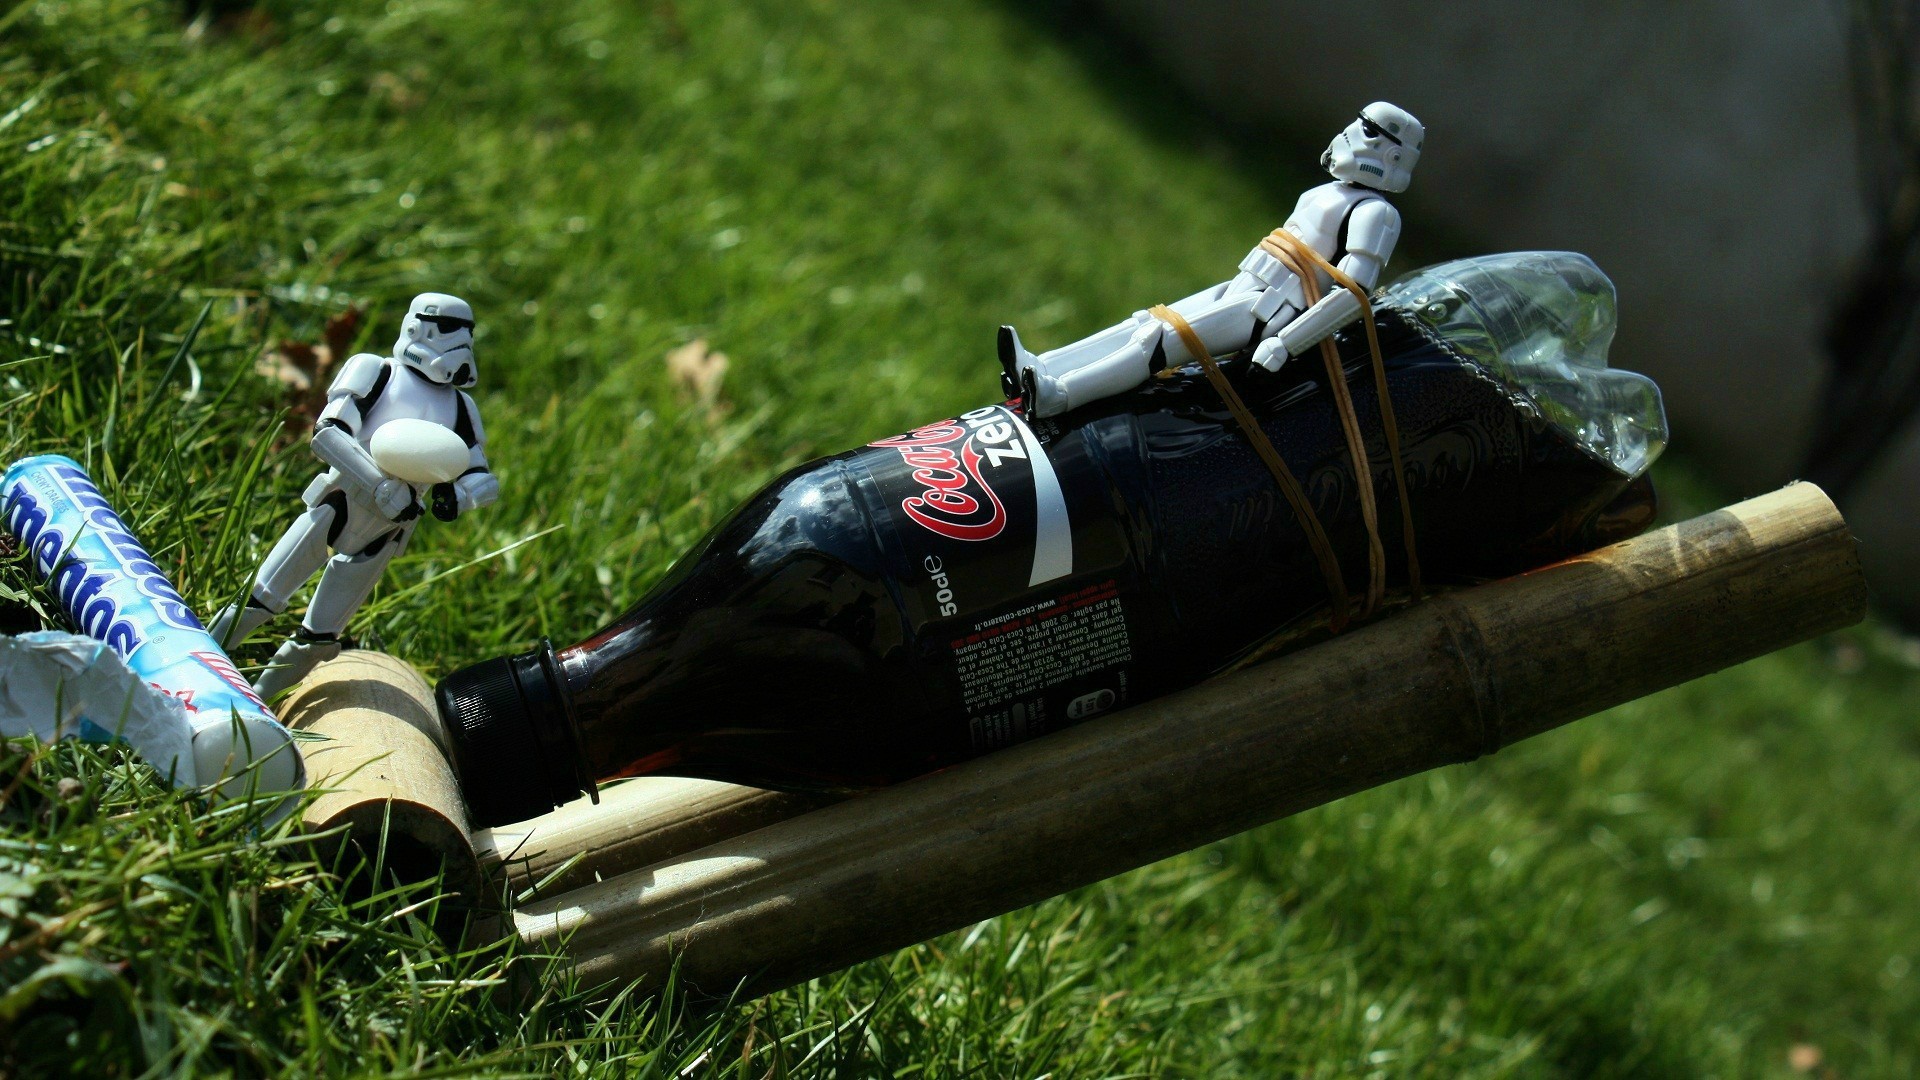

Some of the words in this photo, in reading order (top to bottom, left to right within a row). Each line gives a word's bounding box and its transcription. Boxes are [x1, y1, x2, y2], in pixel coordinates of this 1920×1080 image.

[959, 405, 1027, 468] zero
[1095, 599, 1109, 611] pas
[1110, 597, 1121, 606] Ne
[974, 599, 1056, 632] www.coca-colazero.fr
[1070, 605, 1094, 618] agiter.
[1091, 610, 1108, 621] dans
[1110, 603, 1123, 616] gel
[1040, 617, 1059, 630] 2008
[1079, 616, 1089, 625] un
[1090, 614, 1125, 630] Company.
[1025, 623, 1040, 633] The
[1052, 620, 1078, 635] endroit
[1085, 622, 1126, 642] Conditionné
[988, 628, 1024, 646] Coca-Cola
[1055, 626, 1089, 642] Conserver
[1101, 630, 1128, 644] Camille
[1009, 638, 1023, 648] sec
[1047, 637, 1053, 646] à
[1067, 635, 1084, 646] avec
[1120, 637, 1130, 646] ou
[953, 640, 987, 656] Company.
[980, 646, 997, 657] sans
[999, 643, 1007, 652] et
[1015, 646, 1025, 655] de
[955, 652, 978, 665] odeur.
[978, 653, 1004, 667] chaleur
[1006, 650, 1014, 658] la
[1106, 653, 1132, 666] Chaque
[968, 662, 976, 671] et
[995, 660, 1010, 670] The
[1010, 657, 1020, 665] de
[1033, 654, 1055, 668] 92130
[1081, 658, 1091, 667] de
[957, 665, 967, 674] du
[959, 665, 995, 682] Coca-Cola
[1028, 660, 1063, 676] Coca-Cola
[1075, 662, 1105, 676] bouteille
[1023, 674, 1043, 687] avant
[1039, 681, 1044, 689] 2
[1045, 672, 1073, 687] contient
[963, 688, 975, 697] rue
[995, 685, 1009, 696] voir
[1004, 692, 1013, 700] de
[1015, 684, 1037, 696] verres
[964, 690, 994, 705] bouchon
[988, 695, 1002, 706] 250
